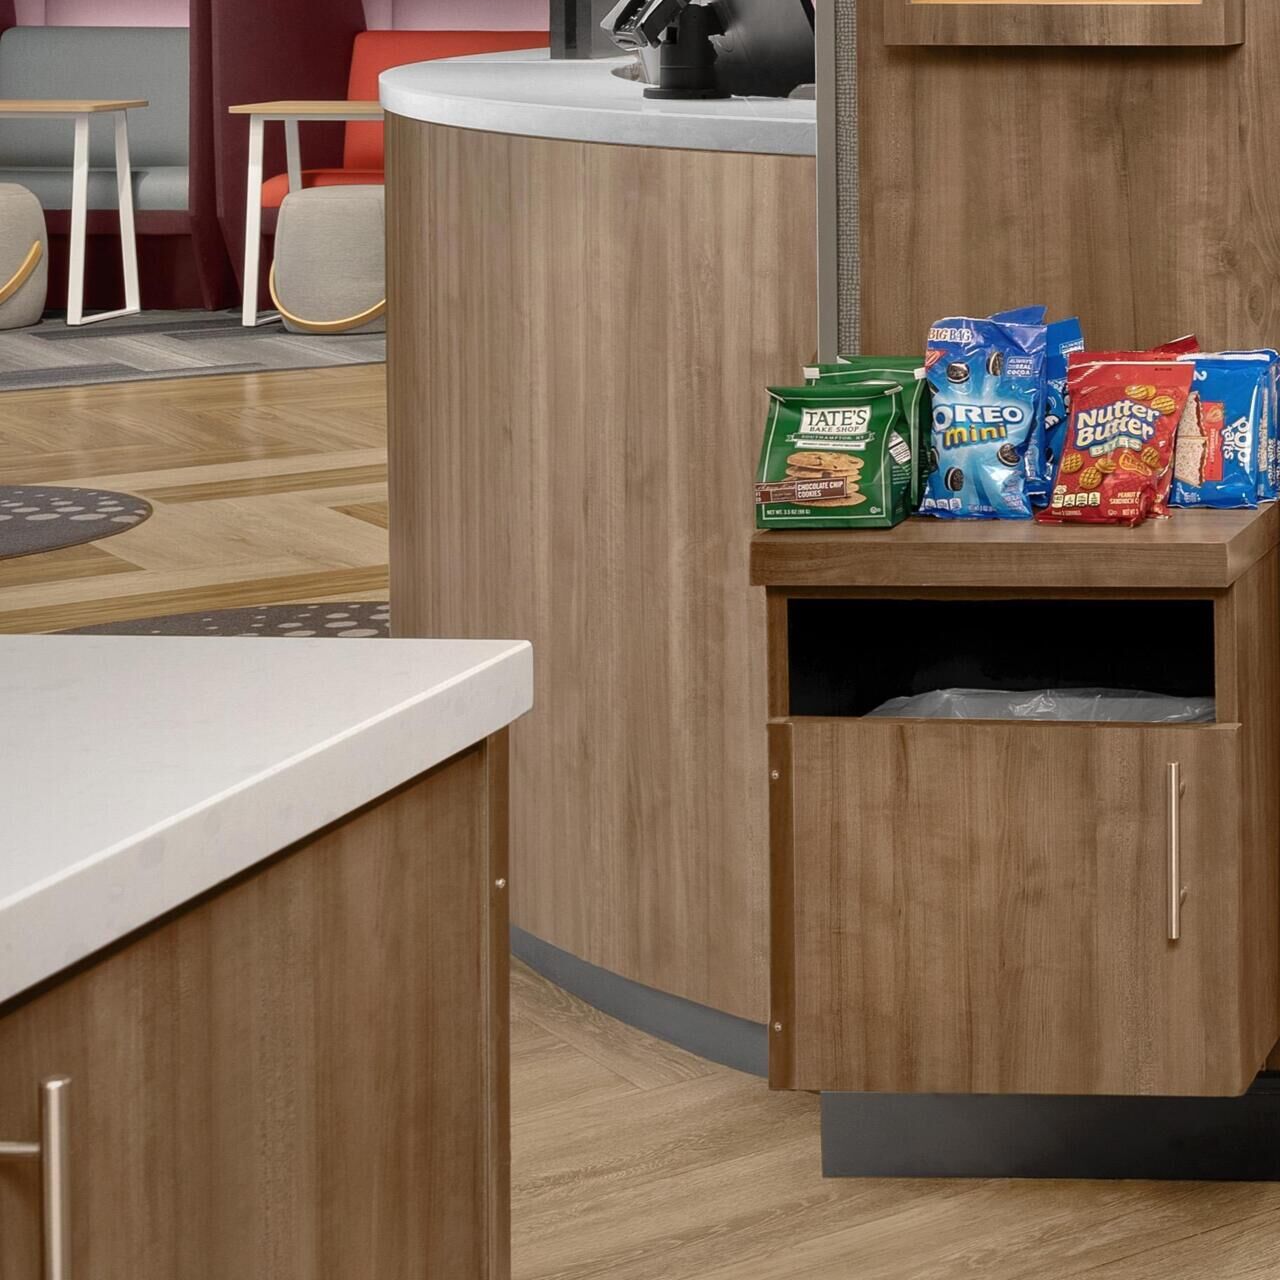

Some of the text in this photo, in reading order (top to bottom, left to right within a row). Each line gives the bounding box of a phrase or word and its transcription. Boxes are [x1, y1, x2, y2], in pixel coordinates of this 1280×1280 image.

[928, 328, 972, 342] BIG BAG
[805, 409, 868, 426] TATE'S
[933, 405, 1024, 430] OREO
[1077, 400, 1159, 428] Nutter
[944, 424, 1007, 446] mini
[1076, 419, 1154, 448] Butter
[797, 482, 829, 491] CHOCOLATE
[797, 490, 822, 498] COOKIES
